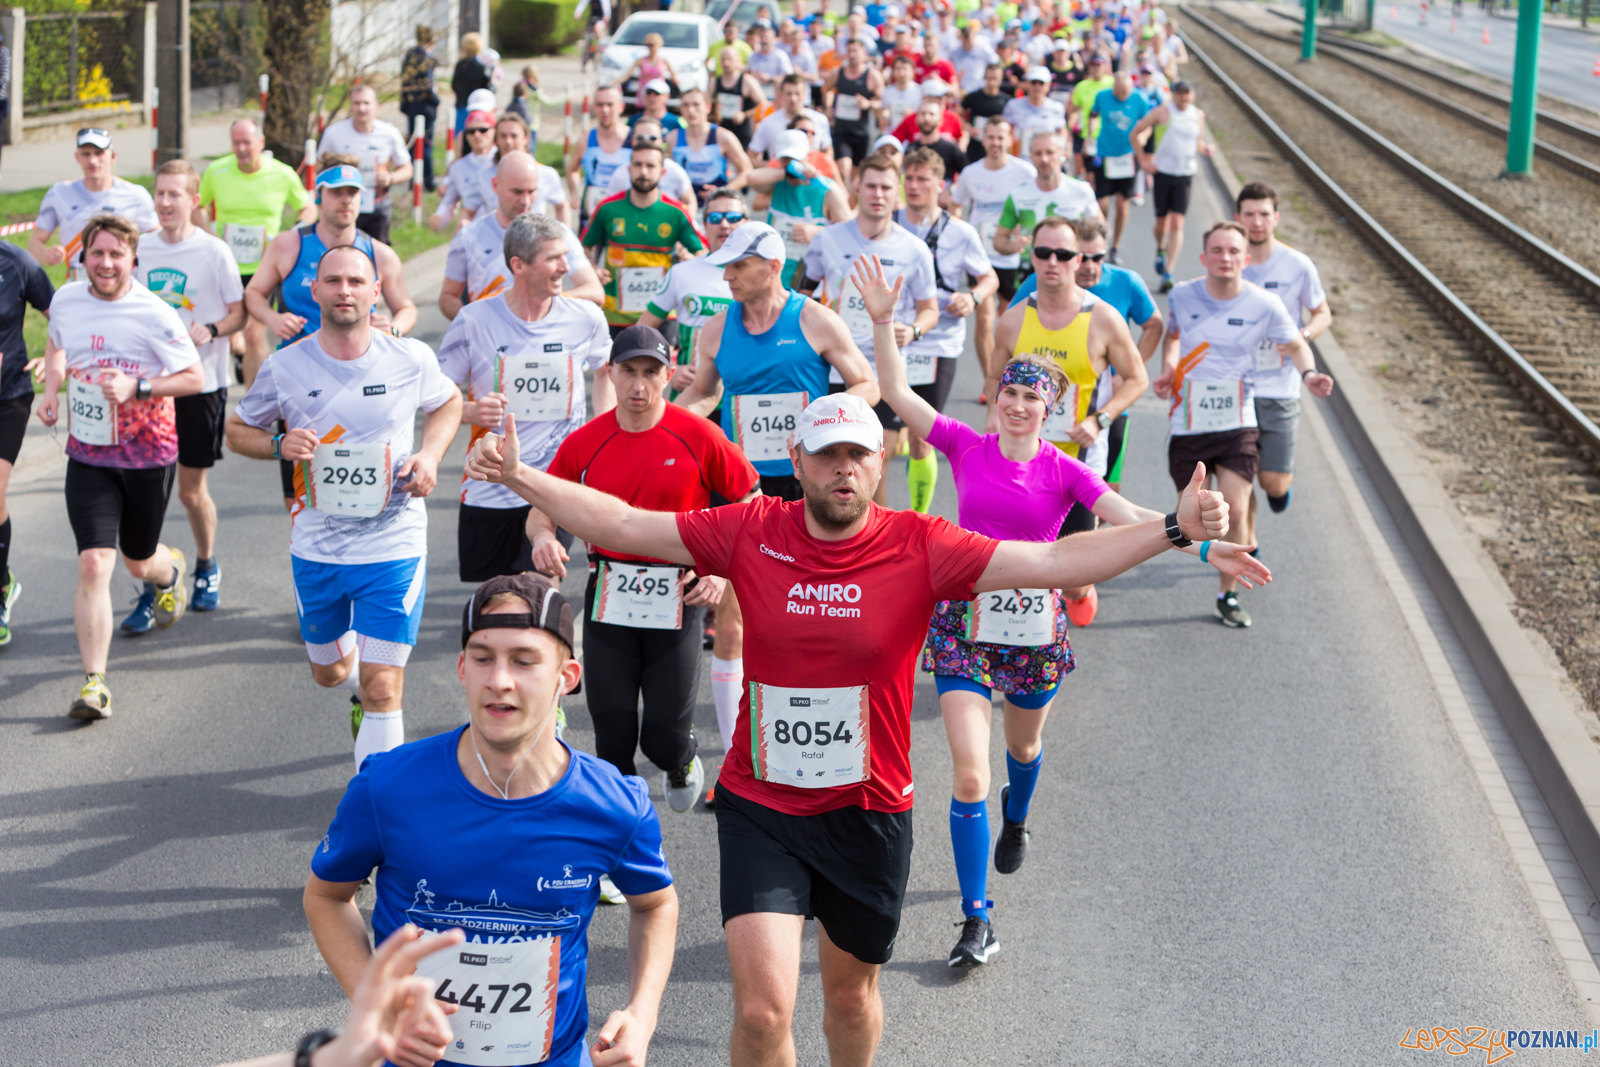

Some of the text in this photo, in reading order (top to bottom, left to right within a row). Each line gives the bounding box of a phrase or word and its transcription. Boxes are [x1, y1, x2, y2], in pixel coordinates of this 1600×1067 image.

[149, 271, 185, 286] BIEGAM
[627, 280, 658, 292] 6622
[90, 335, 105, 350] 10
[365, 385, 385, 394] 11.PKO
[514, 377, 561, 394] 9014
[72, 397, 104, 420] 2823
[1199, 396, 1233, 410] 4128
[751, 414, 796, 433] 6148
[813, 417, 836, 427] ANIRO
[322, 466, 377, 486] 2963
[339, 488, 360, 496] Marcin
[616, 574, 669, 596] 2495
[787, 582, 863, 603] ANIRO
[786, 600, 862, 618] Run Team
[989, 594, 1044, 615] 2493
[774, 719, 853, 746] 8054
[801, 751, 825, 759] Rafał
[462, 955, 486, 963] 11.PKO
[434, 978, 532, 1014] 4472
[469, 1020, 492, 1031] Filip
